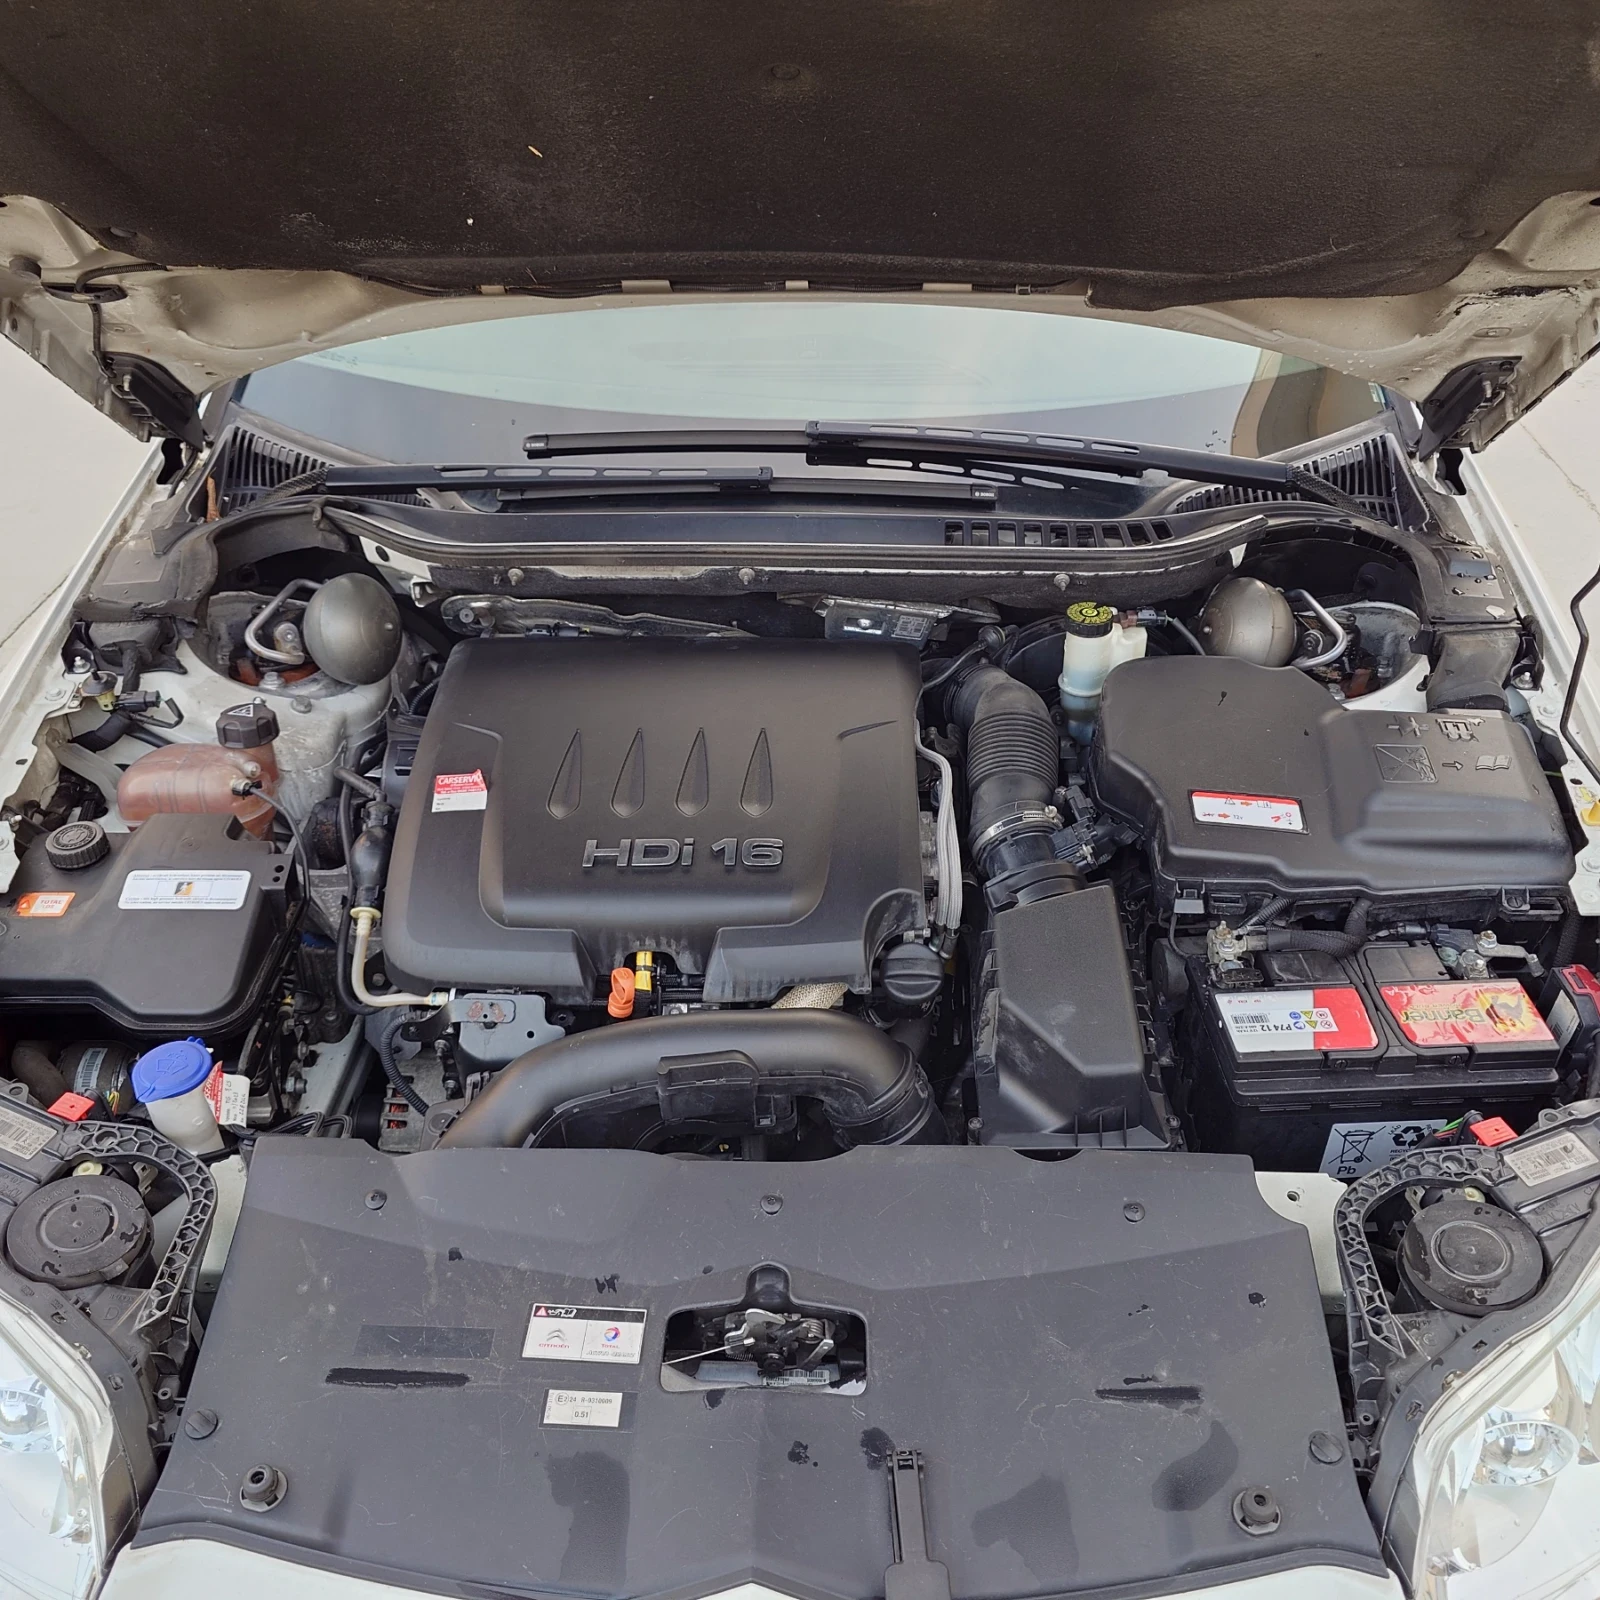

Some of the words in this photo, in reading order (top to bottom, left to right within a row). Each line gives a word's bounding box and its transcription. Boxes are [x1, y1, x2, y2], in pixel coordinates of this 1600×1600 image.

[582, 837, 695, 867] HDi
[711, 837, 784, 867] 16
[1402, 1008, 1486, 1024] Banner
[1336, 1165, 1357, 1175] Pb
